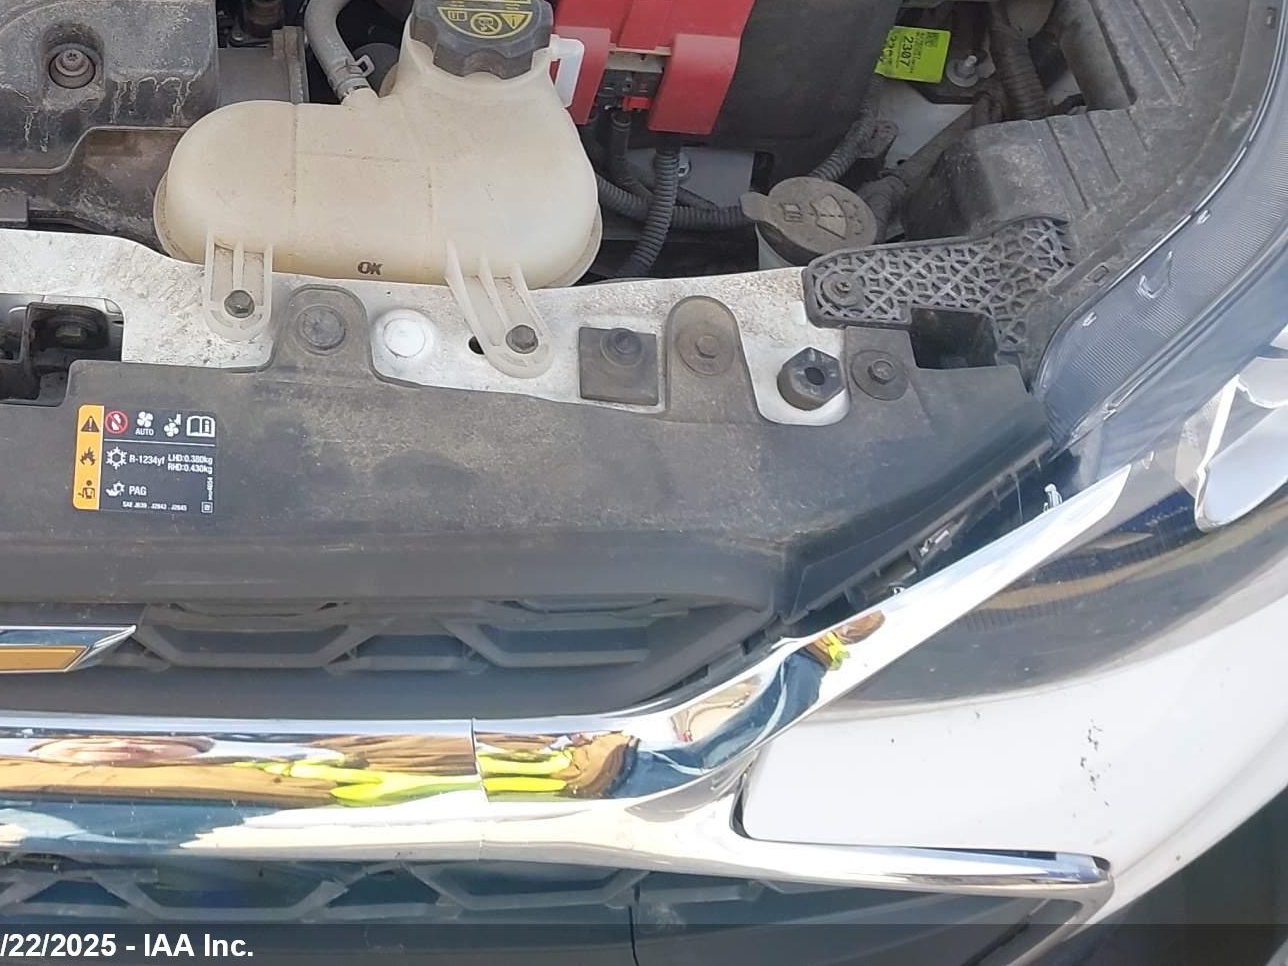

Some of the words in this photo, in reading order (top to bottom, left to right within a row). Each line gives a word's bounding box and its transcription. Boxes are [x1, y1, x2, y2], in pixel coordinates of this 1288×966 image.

[899, 35, 915, 67] 2307
[357, 261, 384, 276] OK
[129, 454, 165, 465] R-1234yf
[129, 485, 147, 496] PAG
